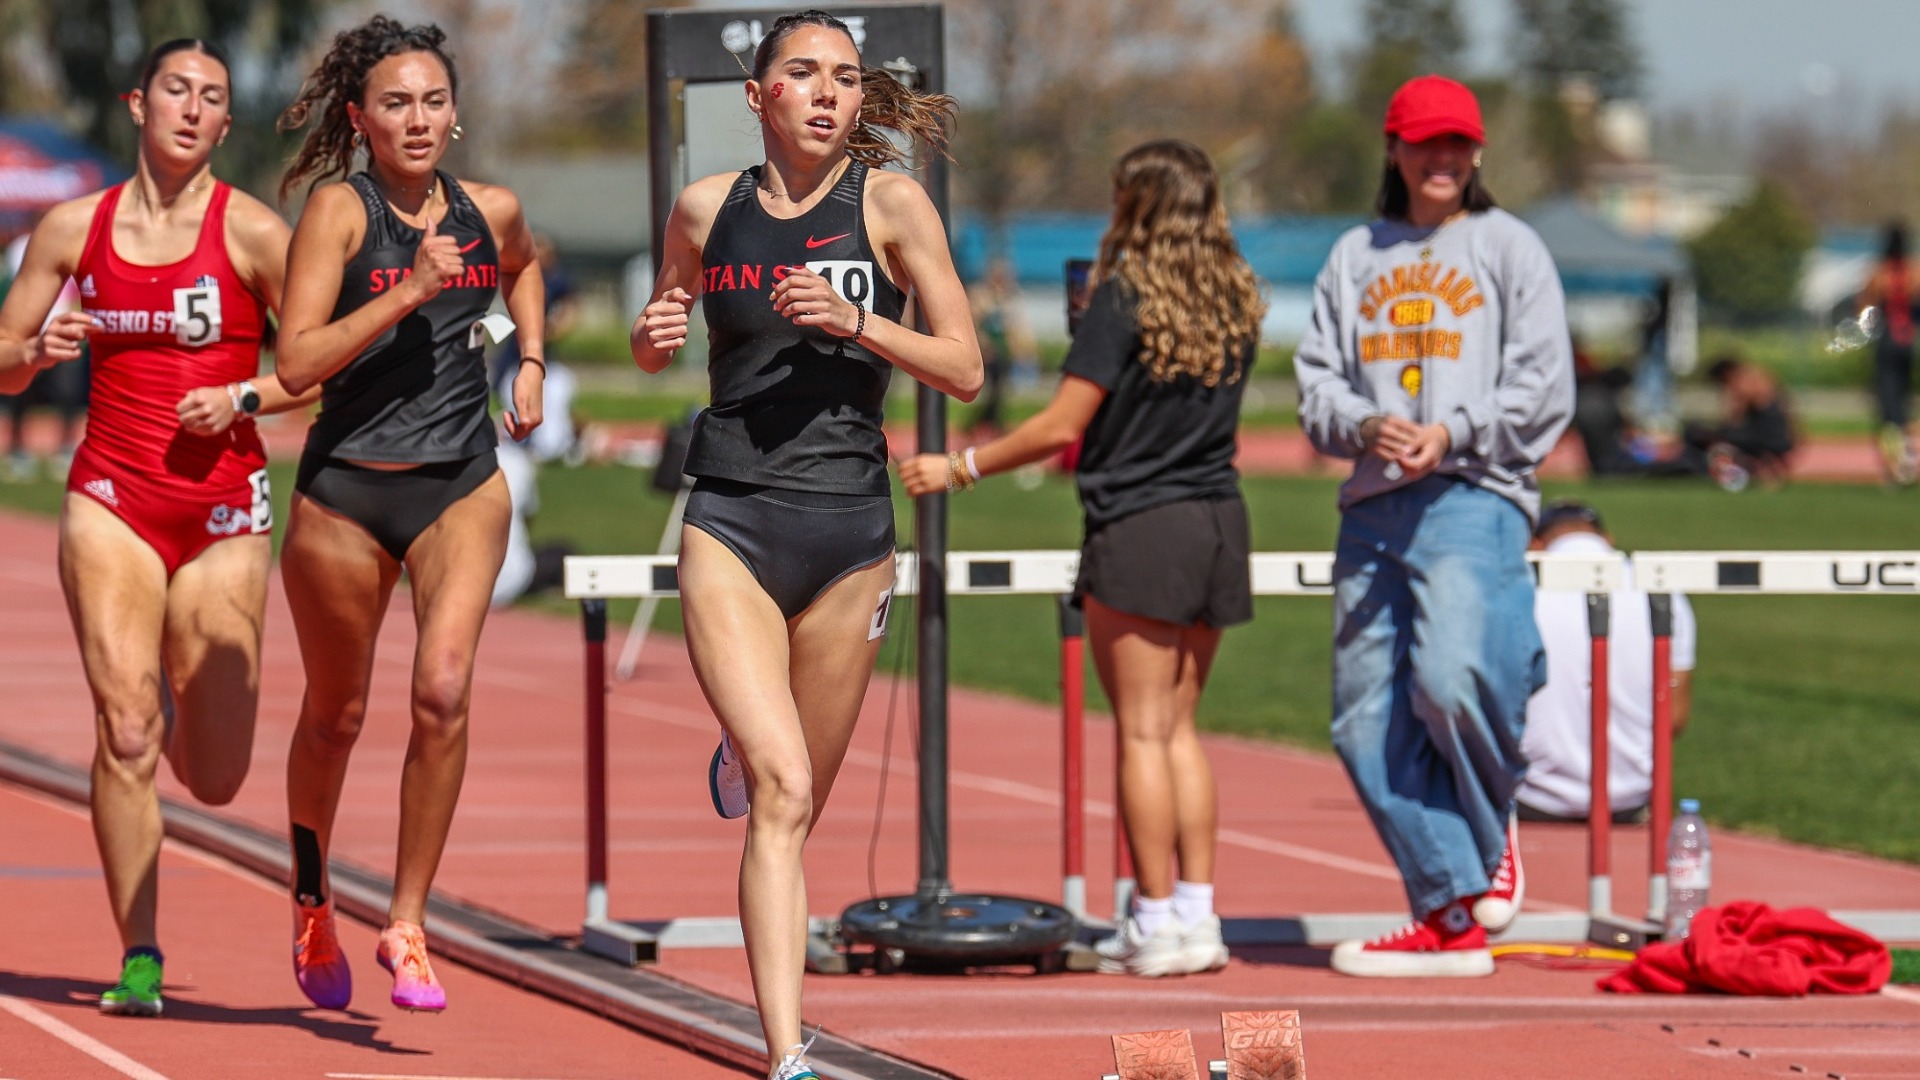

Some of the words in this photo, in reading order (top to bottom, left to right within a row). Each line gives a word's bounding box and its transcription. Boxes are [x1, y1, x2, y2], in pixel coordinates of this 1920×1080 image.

[703, 264, 762, 294] STAN
[772, 264, 806, 289] S
[1359, 262, 1485, 322] STANISLAUS
[187, 292, 211, 343] 5
[876, 587, 895, 628] 1
[1229, 1028, 1298, 1050] GILL
